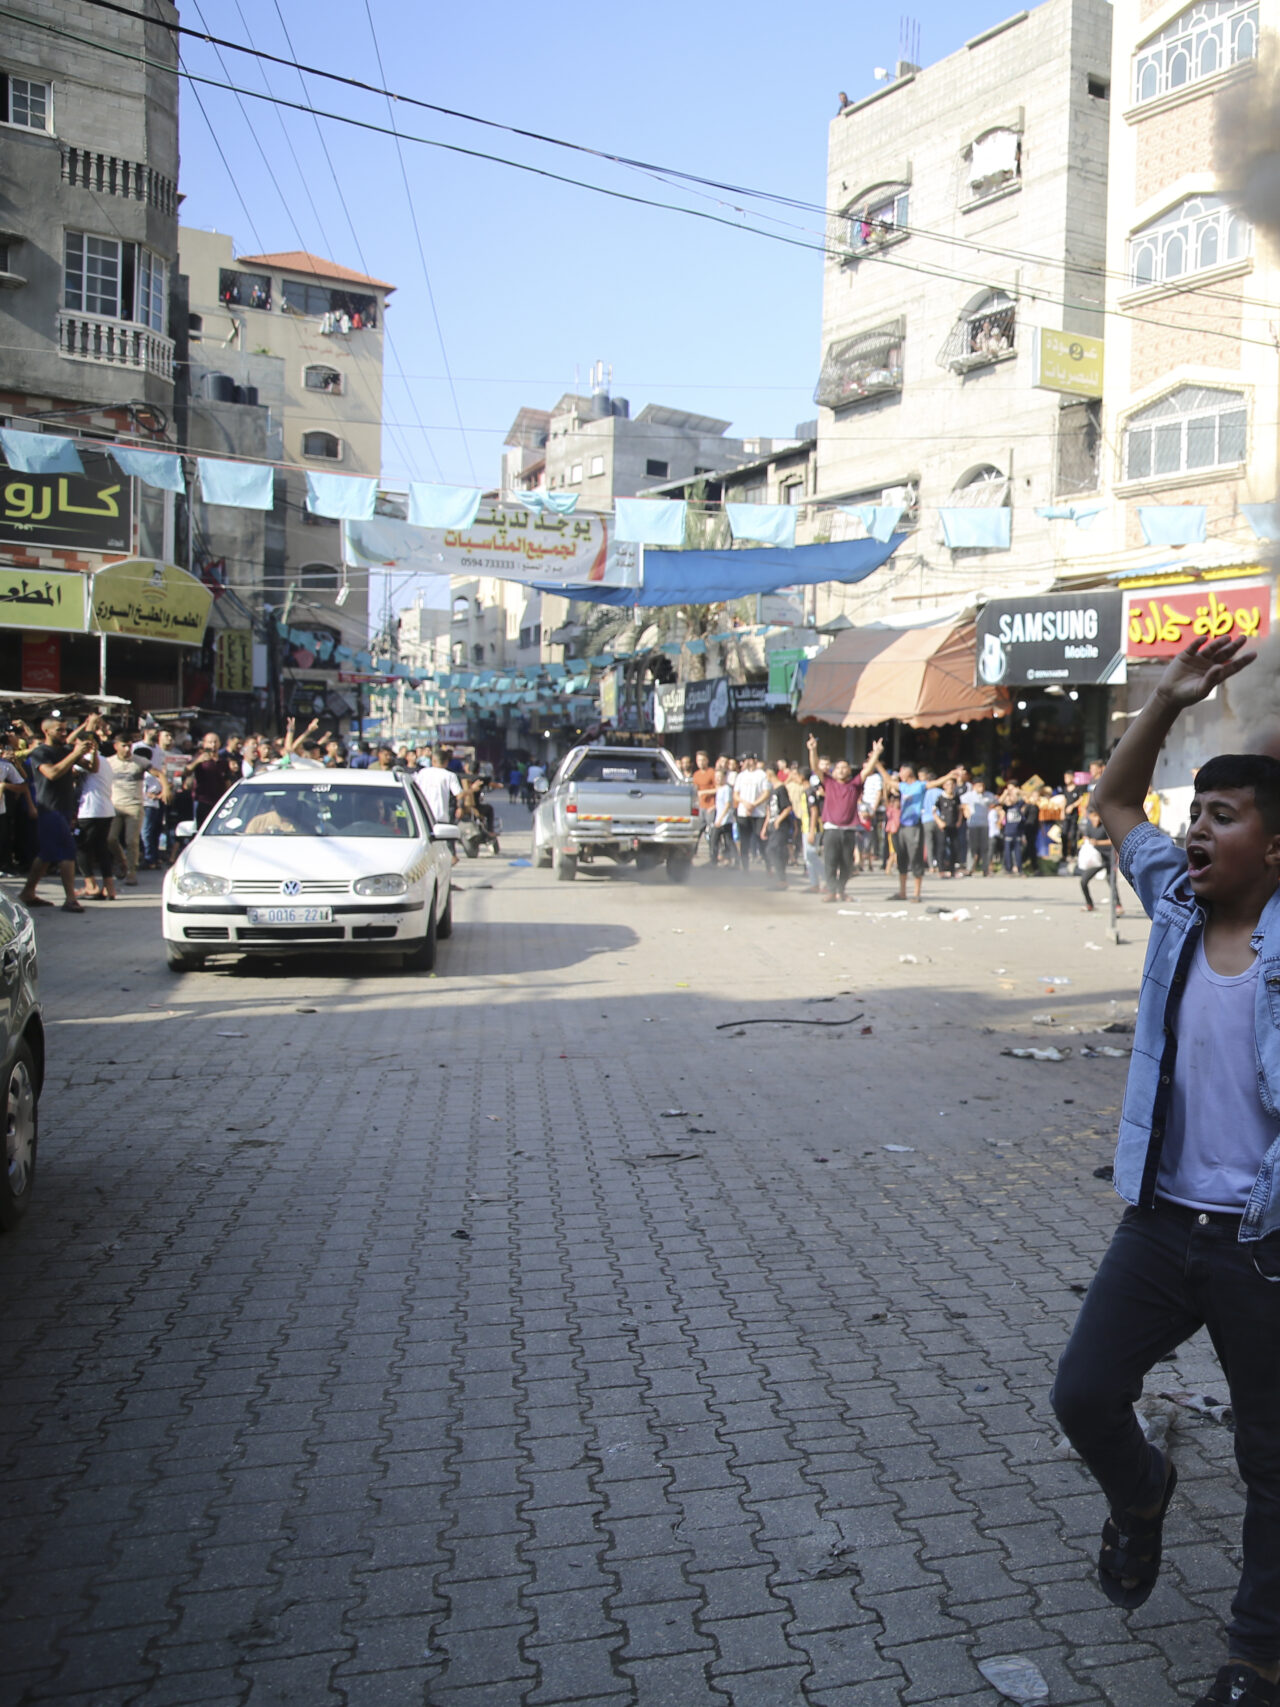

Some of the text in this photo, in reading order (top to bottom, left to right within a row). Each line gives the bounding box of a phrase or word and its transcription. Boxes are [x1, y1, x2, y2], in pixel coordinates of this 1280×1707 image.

[472, 508, 530, 534] لدين
[444, 531, 577, 560] لجميع المناسبات
[461, 557, 482, 567] 0594
[0, 579, 62, 607] المطع
[999, 608, 1098, 644] SAMSUNG
[1128, 592, 1260, 644] بوظة حمادة
[1064, 643, 1099, 659] Mobile
